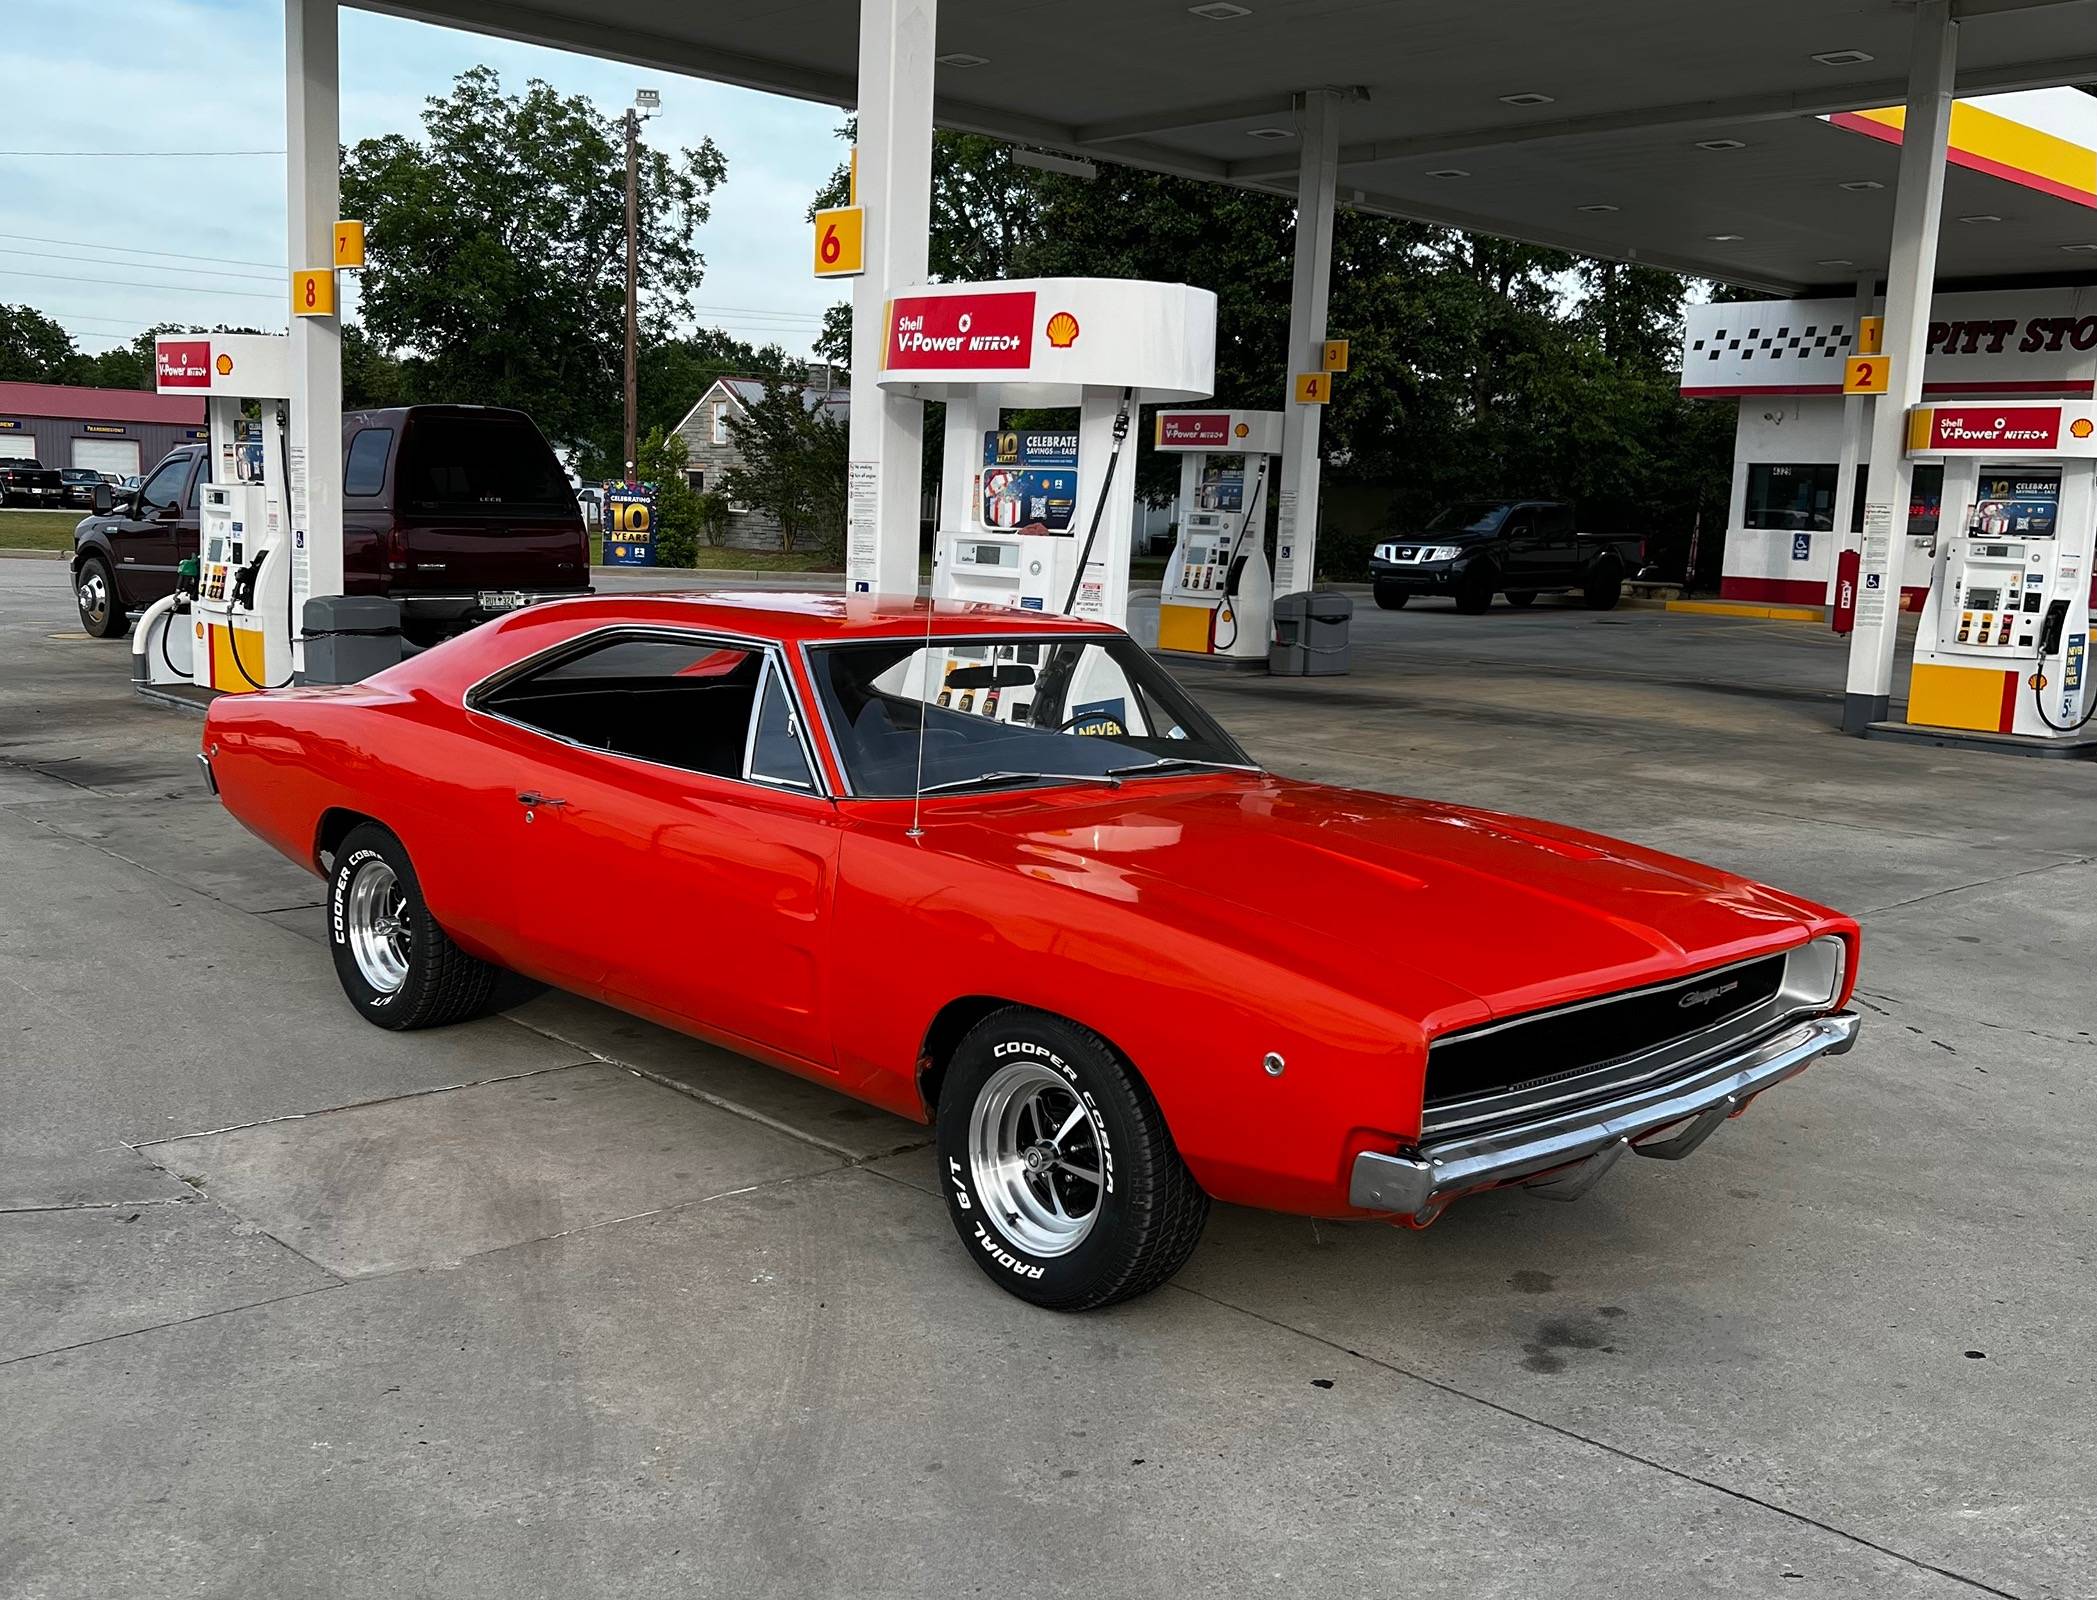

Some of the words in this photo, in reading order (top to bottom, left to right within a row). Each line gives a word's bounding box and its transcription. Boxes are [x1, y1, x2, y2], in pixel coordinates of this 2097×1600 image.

[340, 237, 347, 252] 7
[821, 224, 840, 264] 6
[306, 279, 315, 307] 8
[898, 315, 923, 331] Shell
[898, 333, 964, 351] V-Power
[1869, 328, 1875, 341] 1
[1926, 319, 2017, 355] PITT
[1329, 350, 1337, 360] 3
[1856, 363, 1873, 386] 2
[1306, 379, 1317, 397] 4
[1940, 418, 1963, 427] Shell
[997, 432, 1018, 454] 10
[1026, 436, 1077, 447] CELEBRATE
[1940, 428, 1999, 440] V-Power
[610, 495, 651, 503] CELEBRATING
[610, 502, 650, 531] 10
[615, 533, 648, 541] YEARS
[334, 866, 350, 944] COOPER
[994, 1042, 1077, 1081] COOPER
[1083, 1091, 1113, 1193] COBRA
[950, 1156, 971, 1209] G/T
[974, 1220, 1045, 1279] RADIAL
